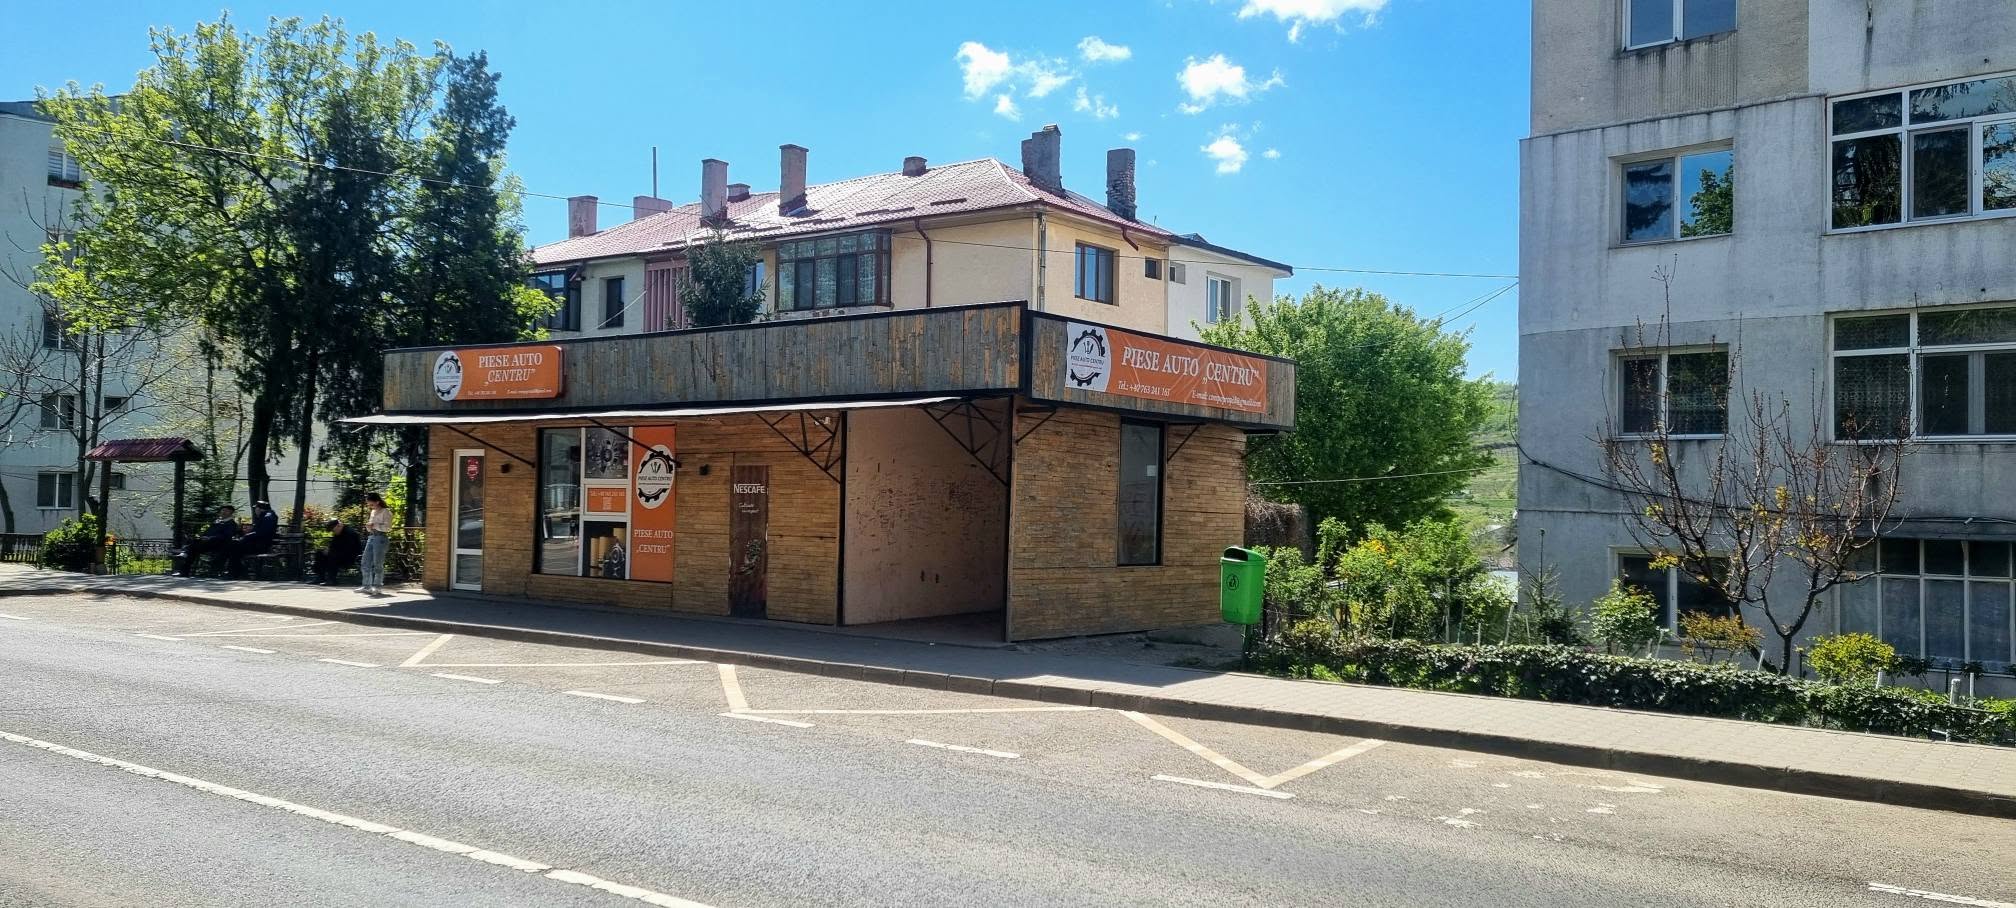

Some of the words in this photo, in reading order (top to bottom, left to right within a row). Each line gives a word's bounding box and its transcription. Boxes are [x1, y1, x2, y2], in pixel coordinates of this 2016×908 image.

[478, 354, 510, 369] PIESE
[511, 352, 543, 366] AUTO
[1121, 346, 1160, 371] PIESE
[1162, 354, 1199, 377] AUTO
[633, 529, 654, 538] PIESE
[654, 529, 673, 539] AUTO
